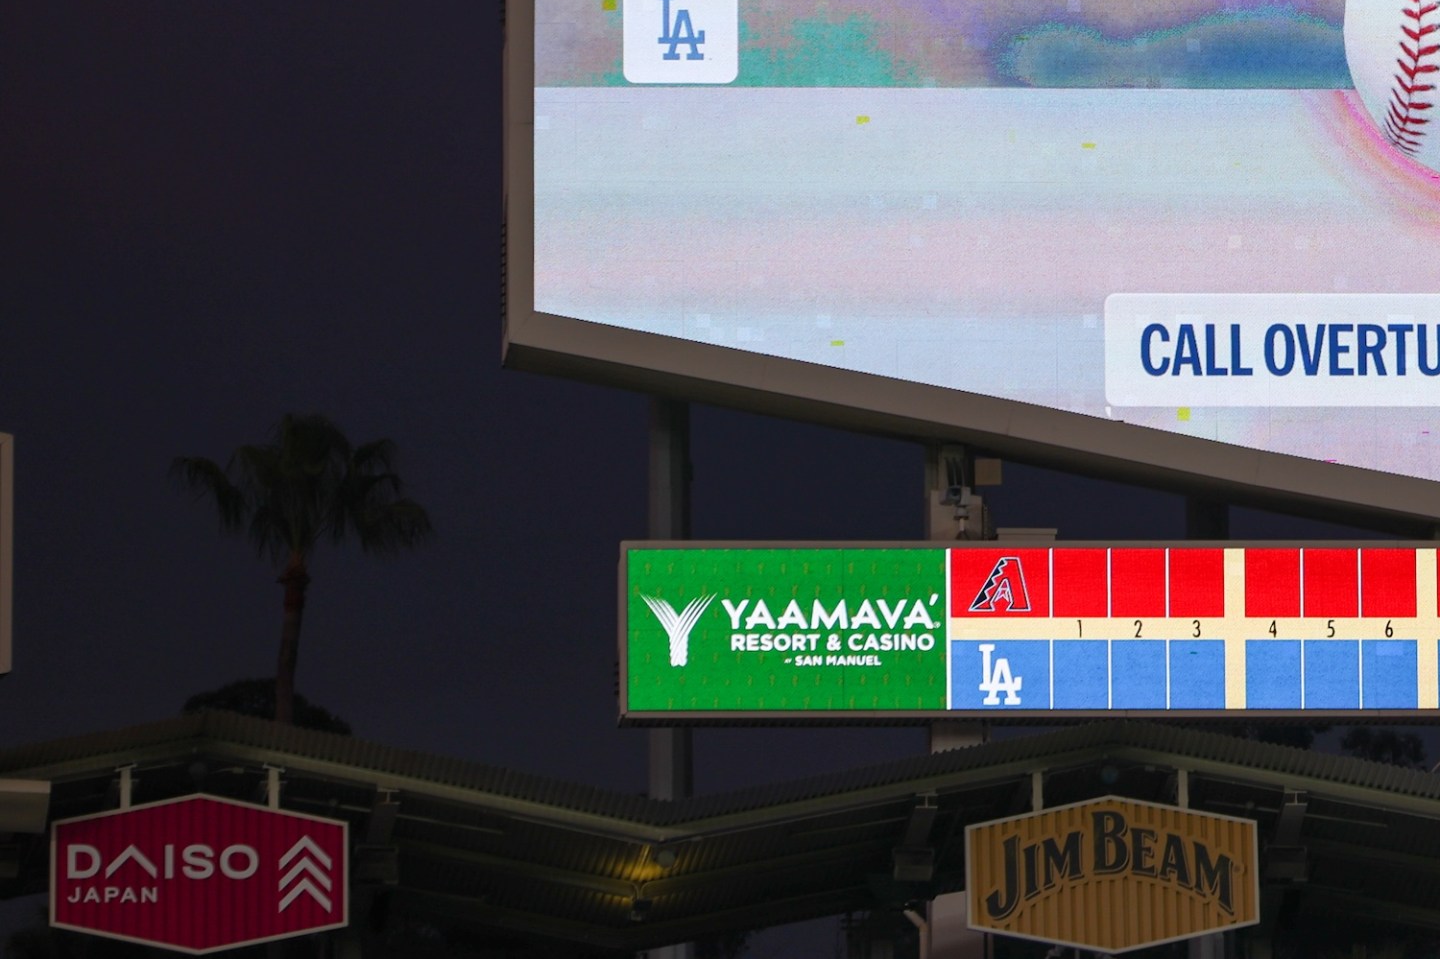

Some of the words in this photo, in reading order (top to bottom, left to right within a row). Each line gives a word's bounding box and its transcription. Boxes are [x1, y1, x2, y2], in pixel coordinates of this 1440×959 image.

[1140, 323, 1254, 376] CALL
[731, 633, 820, 651] RESORT
[826, 633, 841, 651] &
[848, 633, 935, 651] CASINO
[1076, 620, 1083, 638] 1
[1134, 620, 1143, 638] 2
[1192, 620, 1201, 638] 3
[1268, 620, 1277, 638] 4
[1327, 620, 1335, 638] 5
[1385, 620, 1394, 638] 6
[795, 655, 823, 666] SAN
[826, 655, 881, 666] MANUEL
[979, 644, 1022, 705] LA
[67, 844, 259, 880] DAISO
[985, 831, 1084, 920] JIM
[1091, 810, 1235, 917] BEAM
[67, 887, 158, 903] JAPAN
